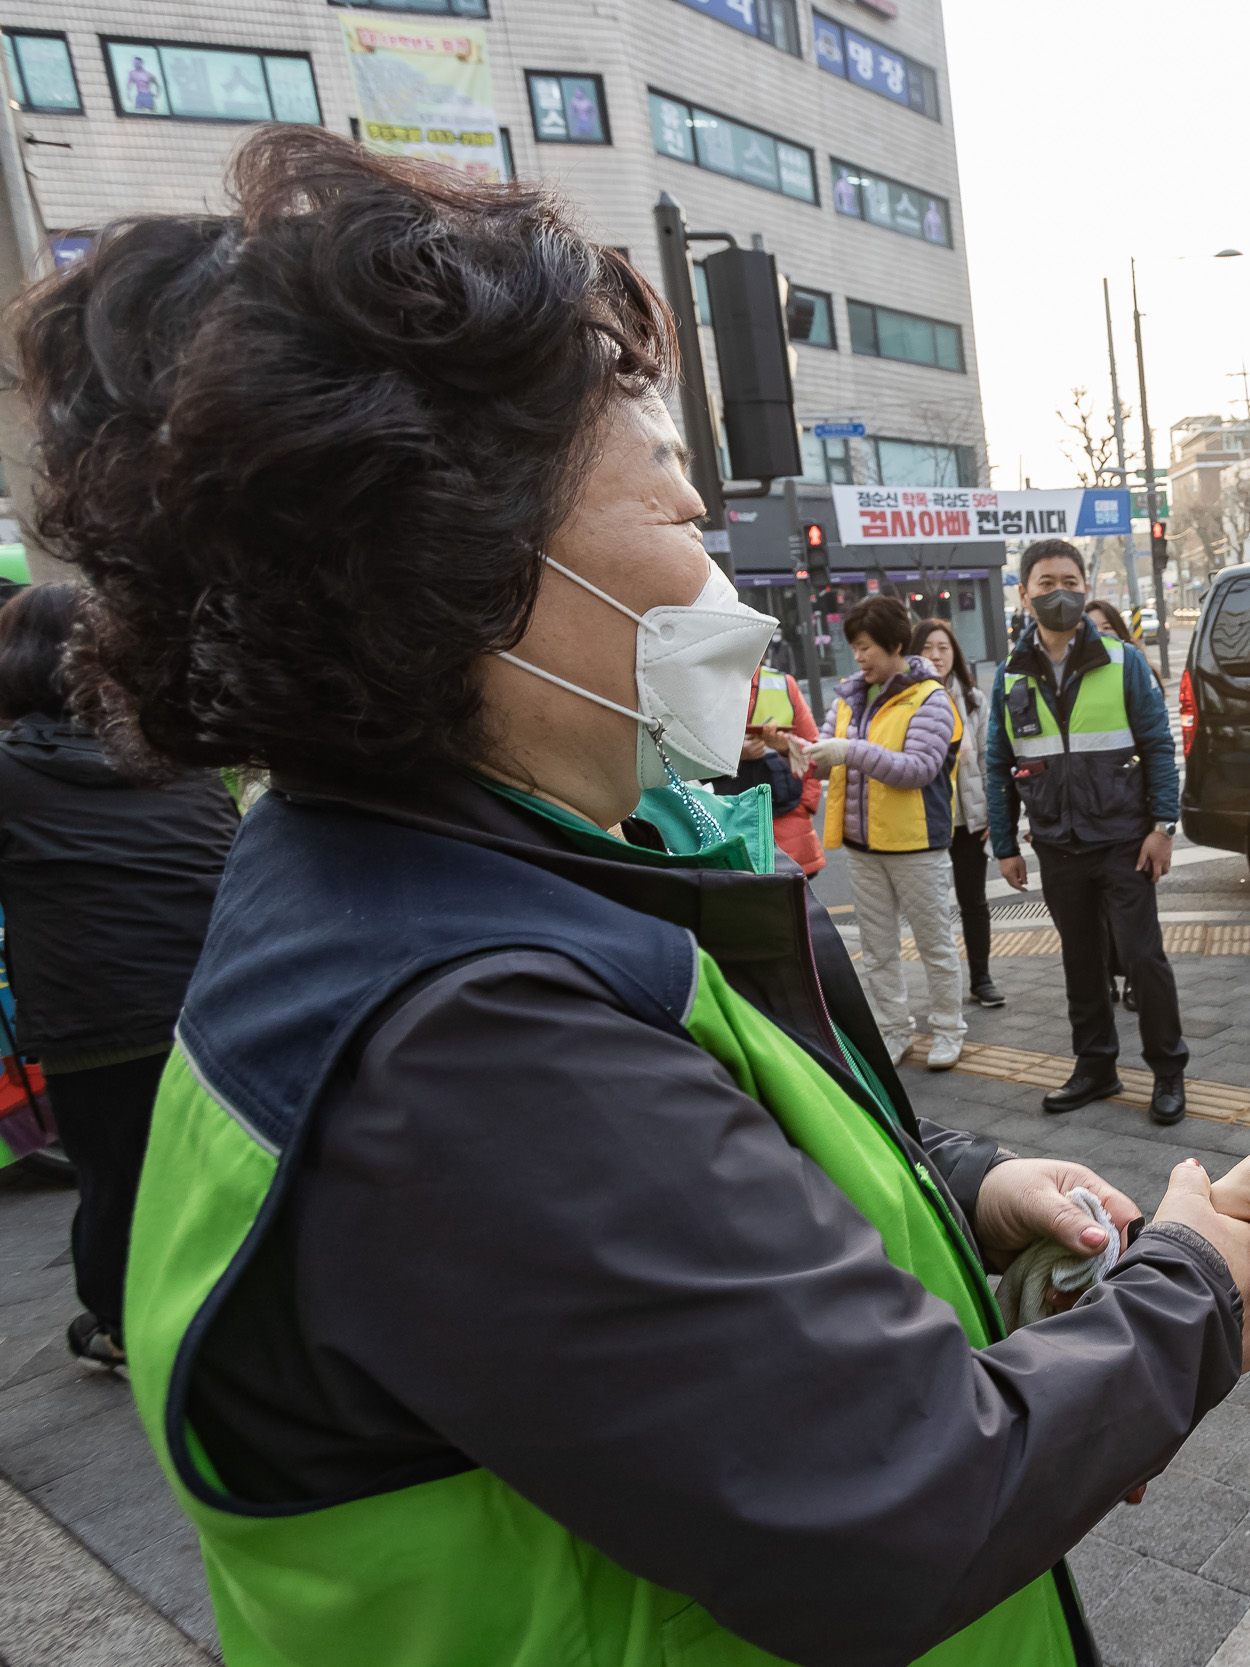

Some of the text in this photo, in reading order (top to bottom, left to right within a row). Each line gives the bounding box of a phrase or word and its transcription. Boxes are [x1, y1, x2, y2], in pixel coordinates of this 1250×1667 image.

[847, 40, 906, 95] 명장
[857, 491, 899, 508] 정순신
[972, 493, 998, 508] 50억
[859, 510, 1067, 538] 검사아빠 전성시대
